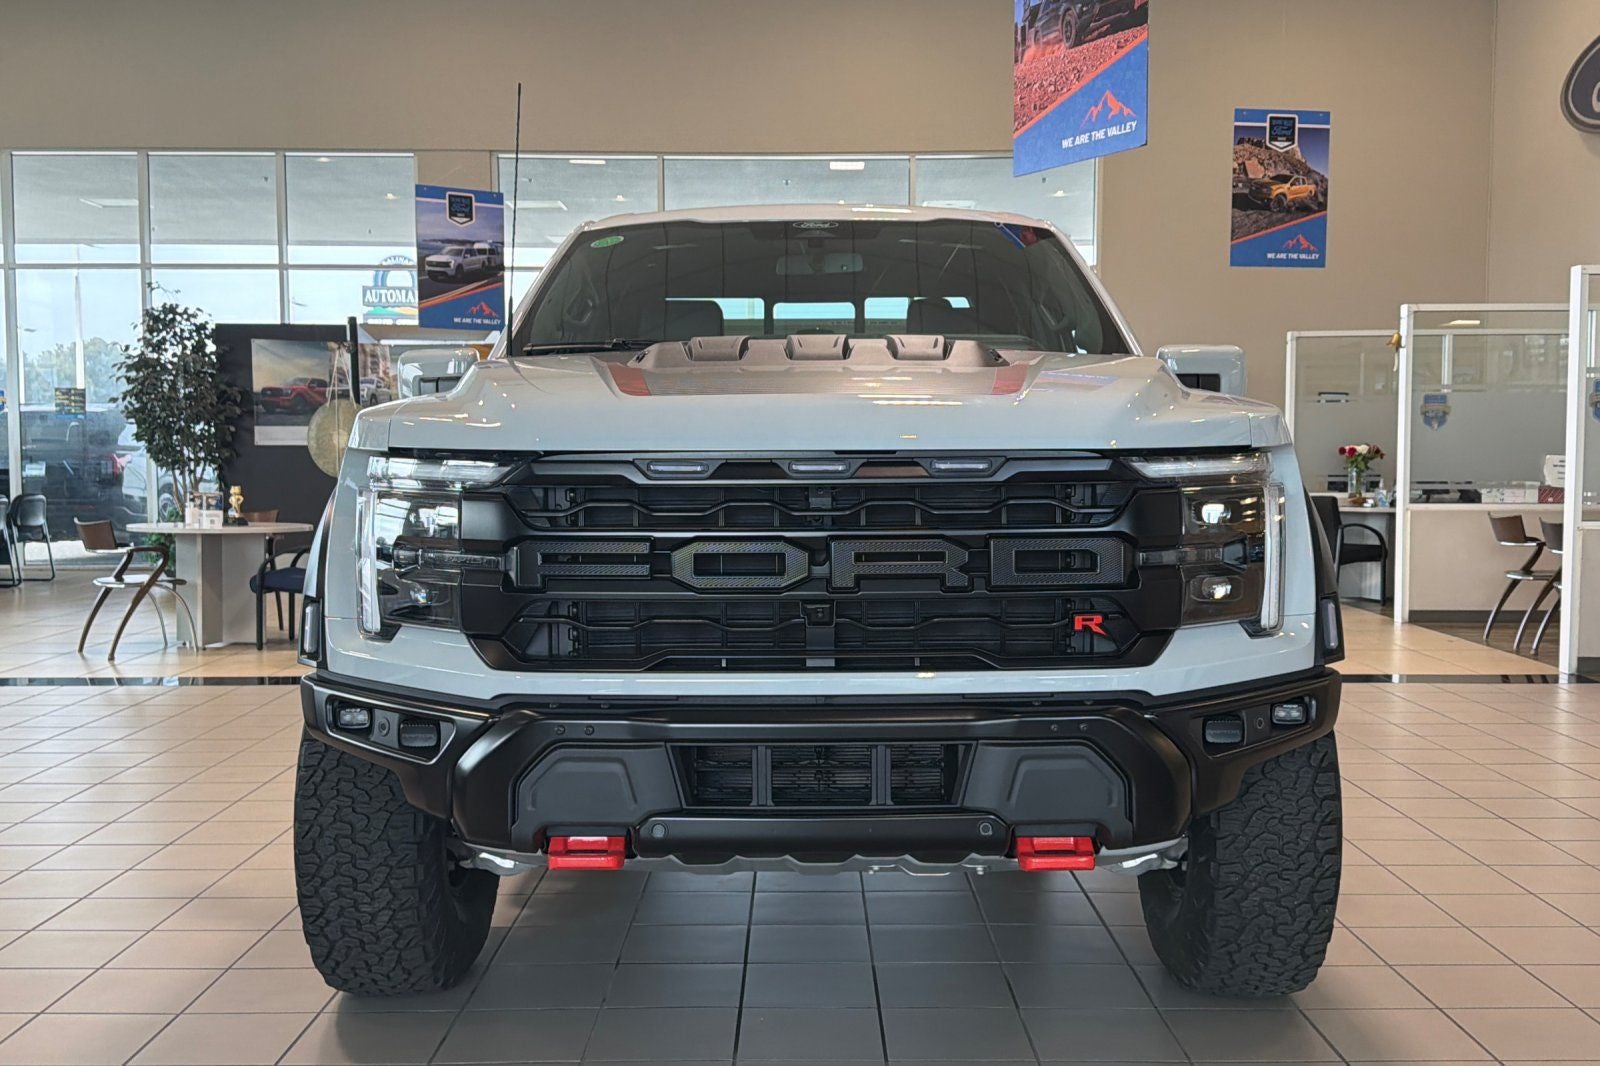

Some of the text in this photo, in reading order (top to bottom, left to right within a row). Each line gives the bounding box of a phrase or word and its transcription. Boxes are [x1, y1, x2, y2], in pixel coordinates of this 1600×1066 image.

[1062, 120, 1137, 149] WE ARE THE VALLEY
[364, 289, 418, 303] AUTOMA
[516, 538, 1124, 588] FORD
[1074, 615, 1107, 636] R
